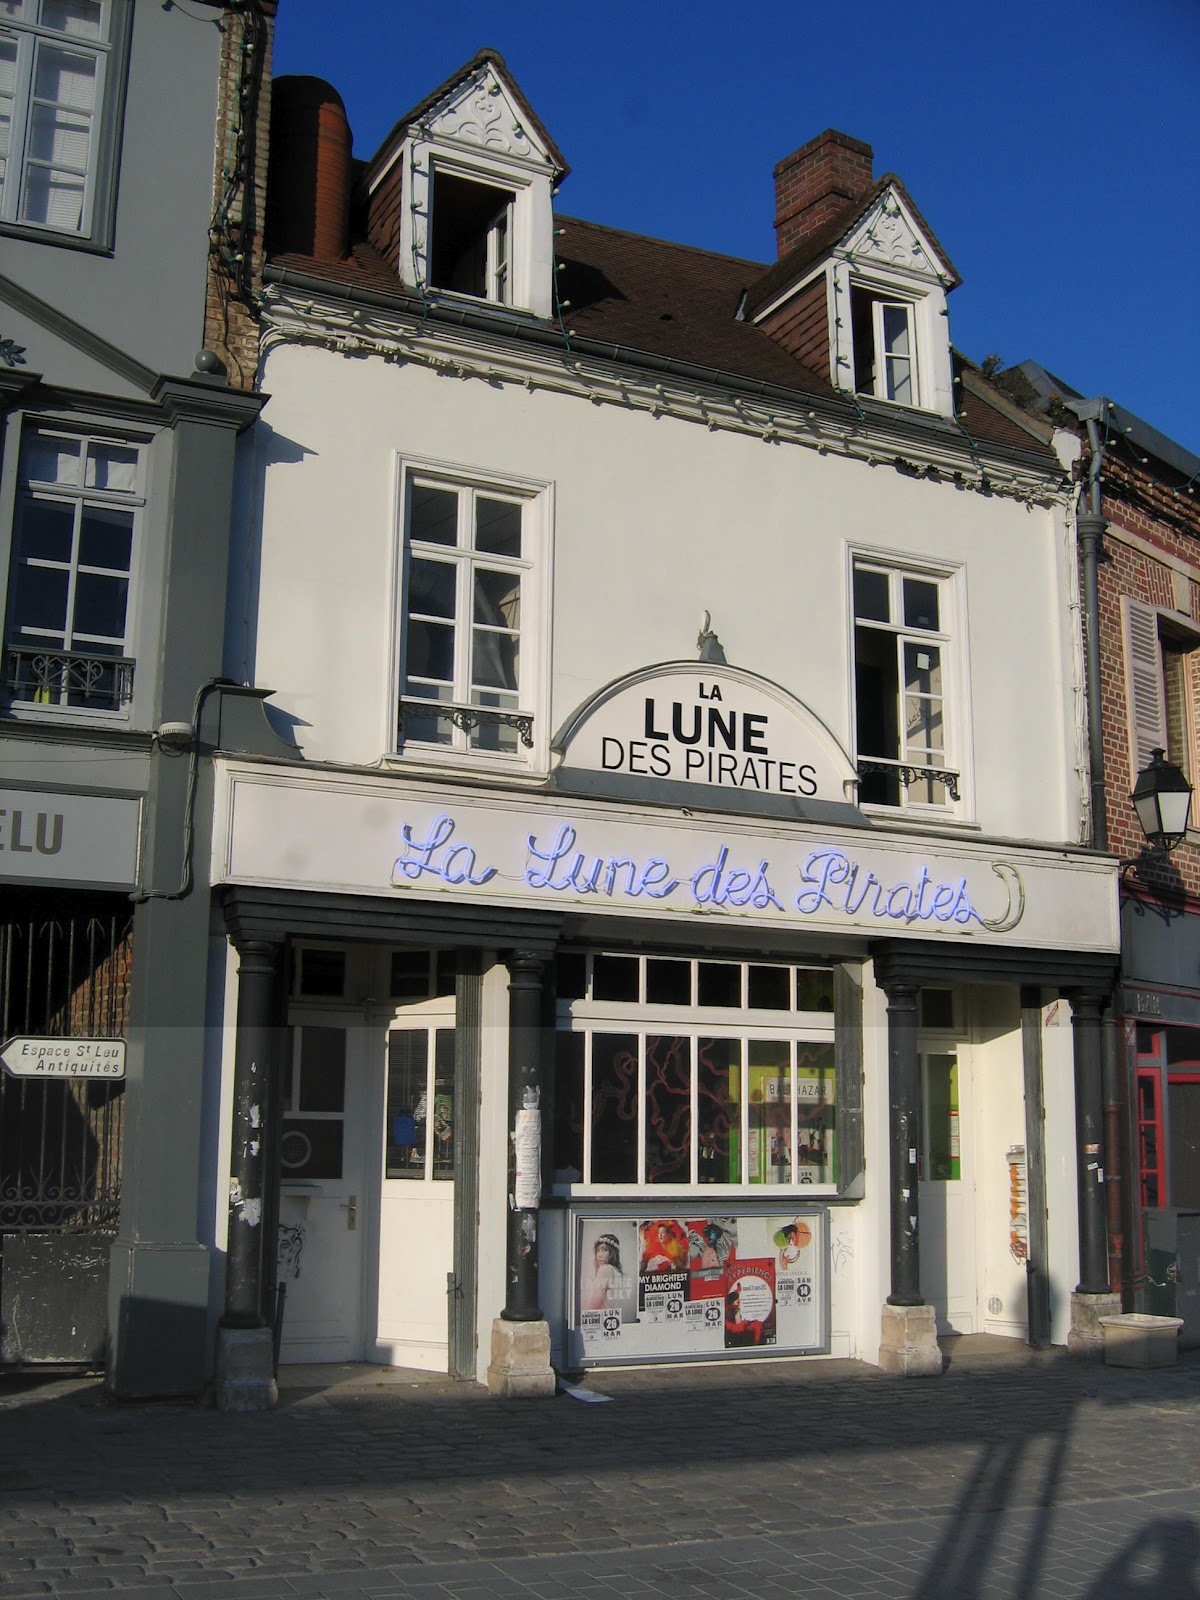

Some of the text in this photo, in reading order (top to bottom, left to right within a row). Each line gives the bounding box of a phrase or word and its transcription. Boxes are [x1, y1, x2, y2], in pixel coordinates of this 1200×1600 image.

[698, 682, 723, 701] LA
[645, 697, 768, 755] LUNE
[602, 736, 818, 796] DES PIRATES
[398, 813, 985, 925] La Lune des Pirates
[21, 1044, 70, 1058] Espace
[95, 1046, 119, 1057] Leu
[36, 1060, 119, 1075] Antiquités
[651, 1273, 688, 1283] BRIGHTEST
[644, 1281, 681, 1292] DIAMOND
[800, 1285, 809, 1296] 14
[603, 1309, 620, 1317] LUN
[606, 1318, 618, 1329] 26
